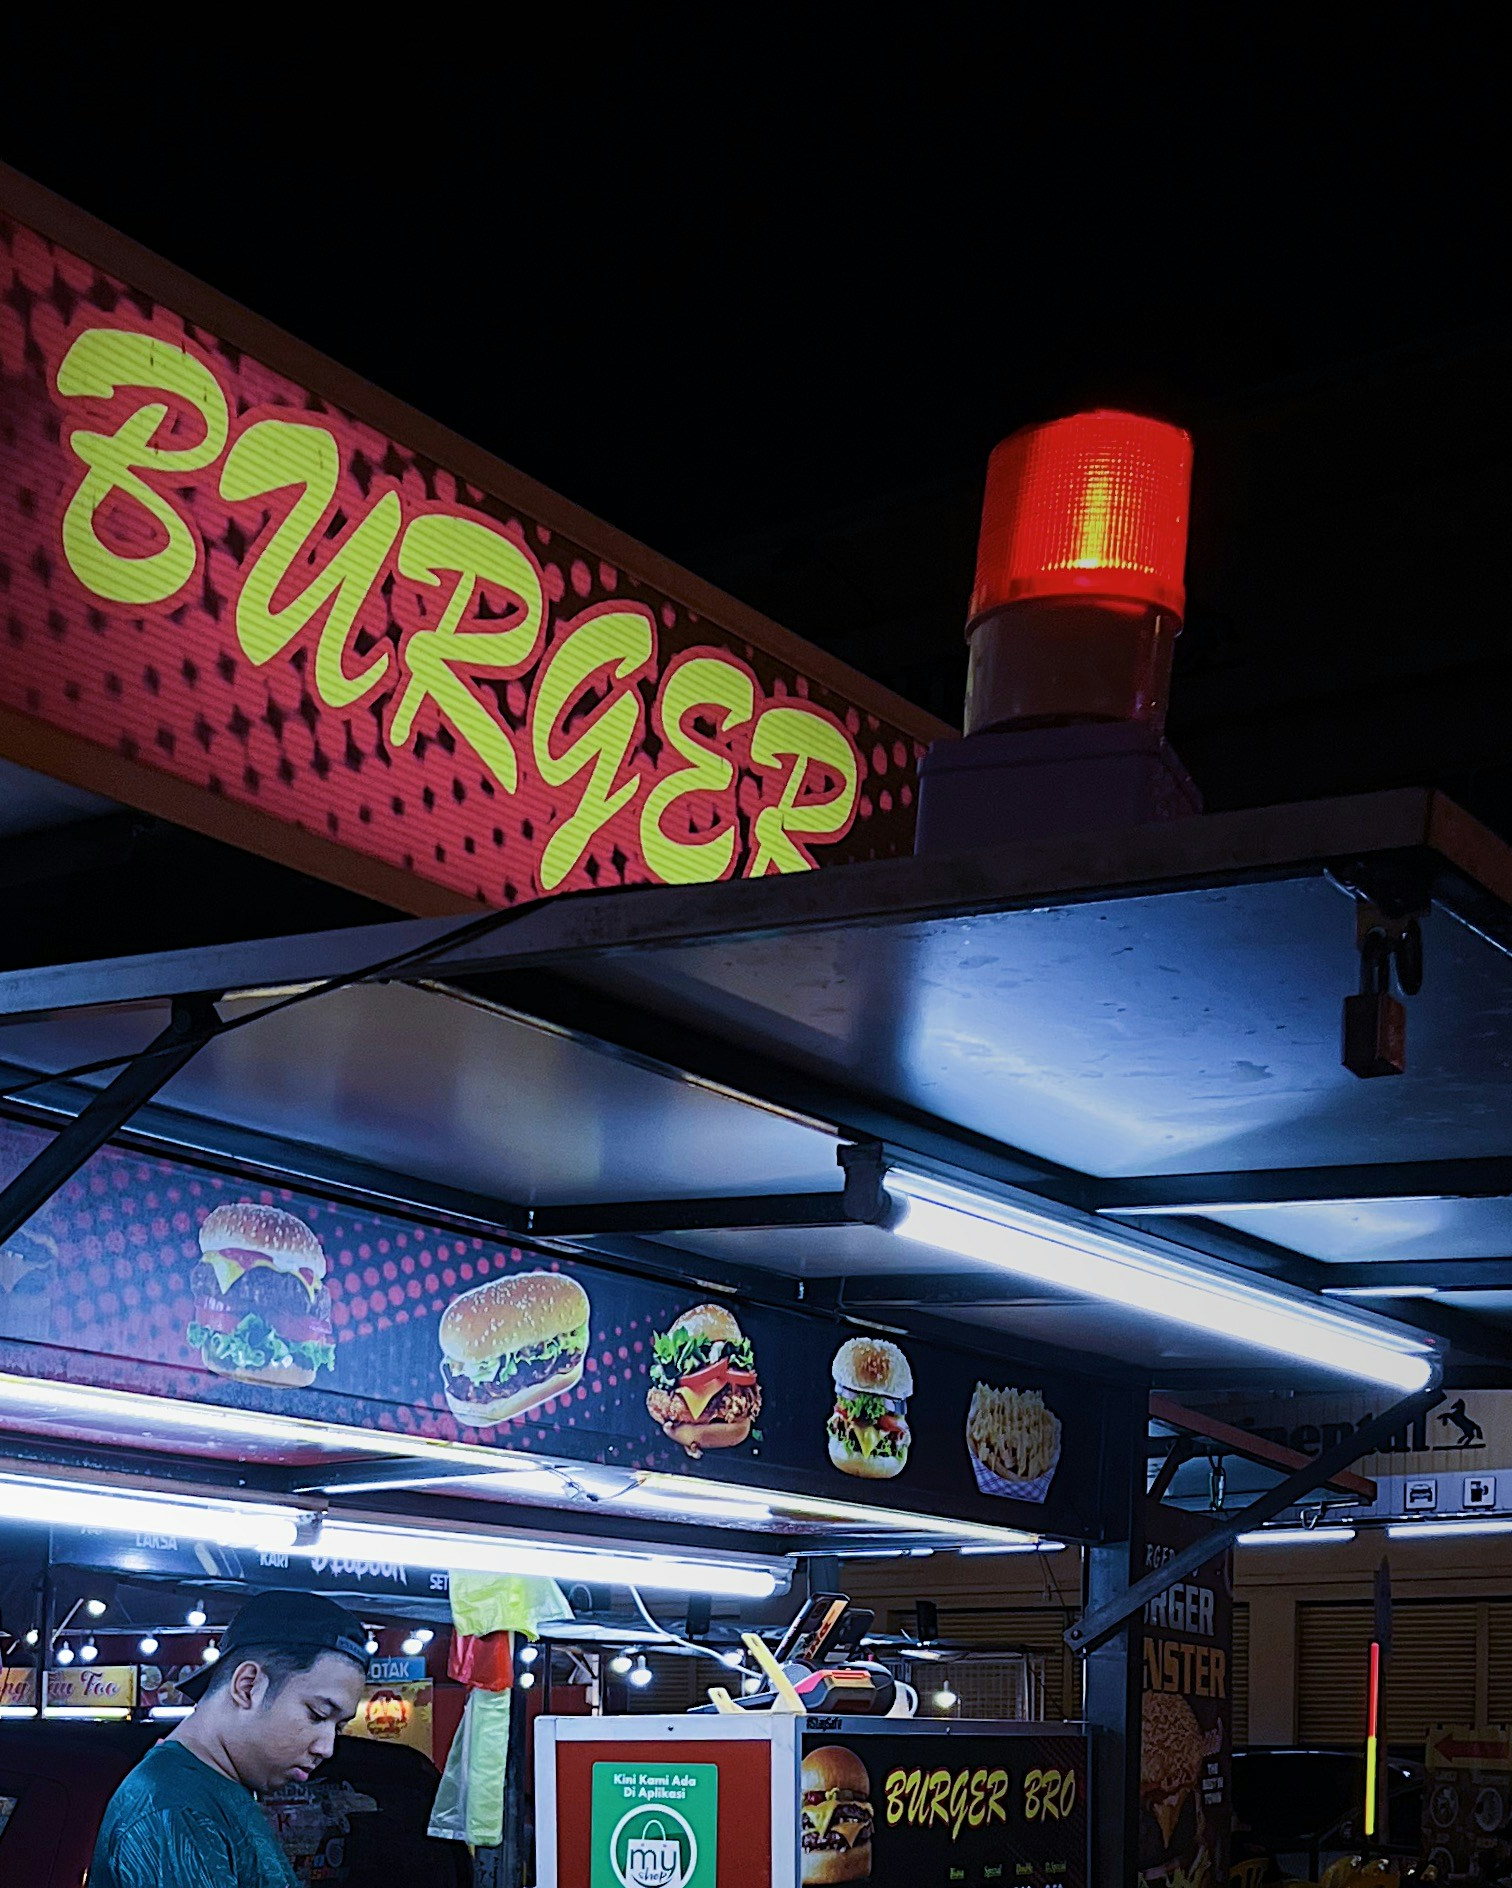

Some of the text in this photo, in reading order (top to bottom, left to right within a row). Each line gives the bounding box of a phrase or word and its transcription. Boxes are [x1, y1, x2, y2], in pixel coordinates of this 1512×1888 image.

[56, 327, 858, 890] BURGER
[1143, 1636, 1227, 1699] NSTER
[613, 1773, 697, 1787] Kini Kami Ada
[623, 1786, 686, 1802] Di Aplikasi
[884, 1768, 1076, 1844] BURGER BRO
[630, 1848, 677, 1877] my
